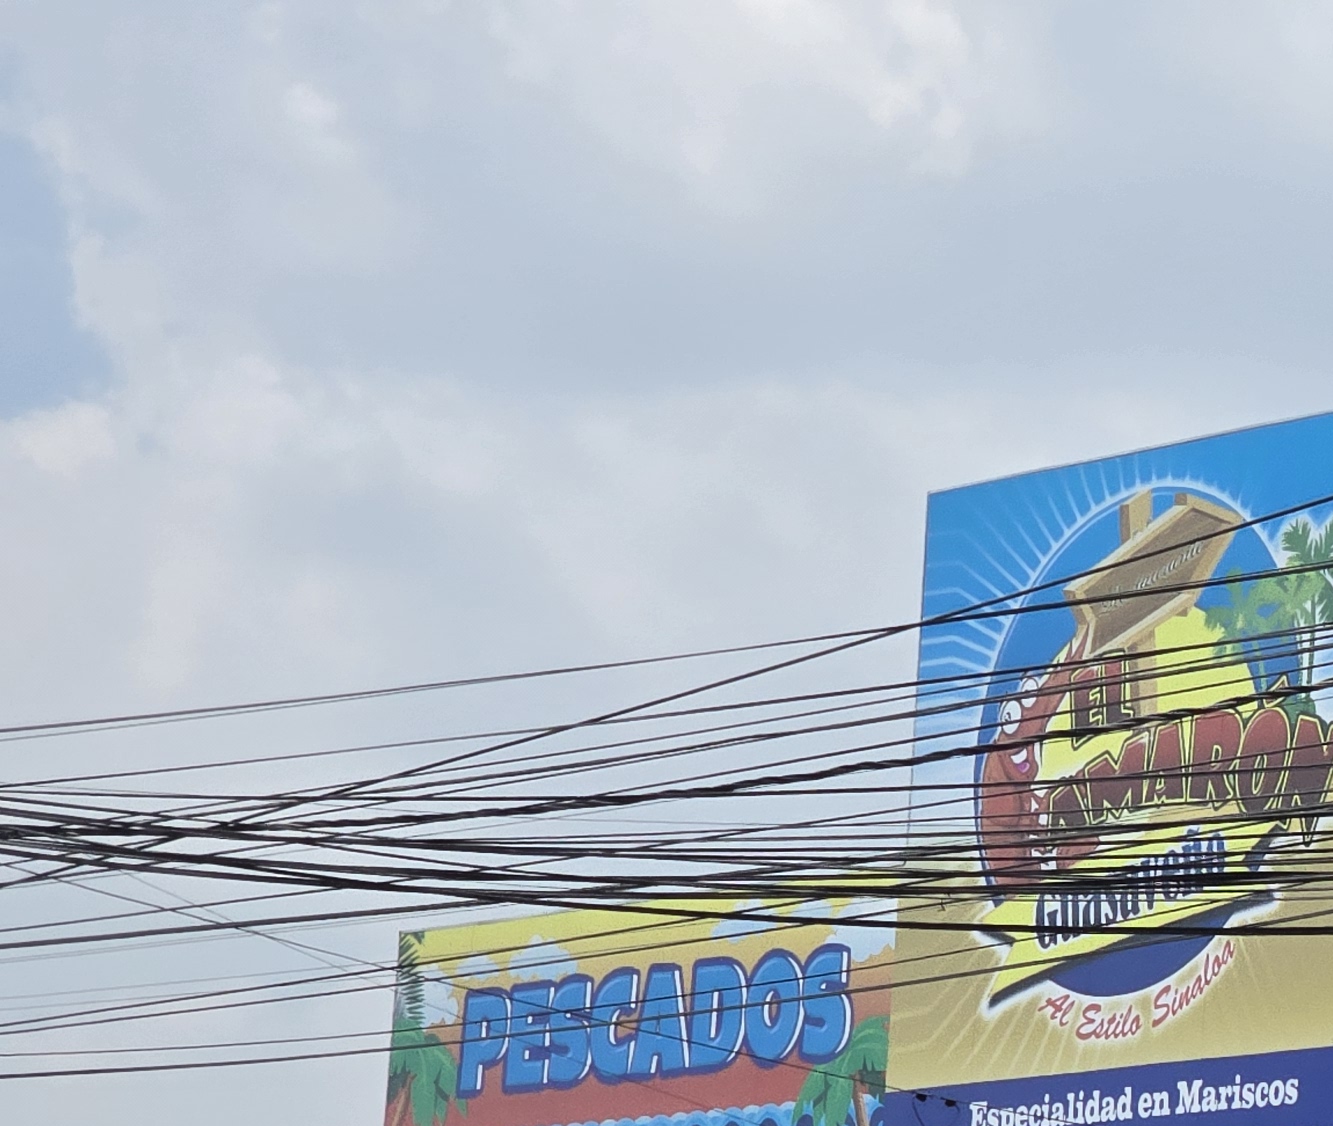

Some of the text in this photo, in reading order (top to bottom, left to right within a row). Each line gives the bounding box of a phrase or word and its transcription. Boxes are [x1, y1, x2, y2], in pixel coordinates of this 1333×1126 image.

[1070, 648, 1136, 752] EL
[457, 943, 854, 1098] PESCADOS
[1037, 940, 1235, 1040] Al Estilo Sinaloa
[1138, 1091, 1171, 1119] en
[1175, 1074, 1299, 1115] Mariscos
